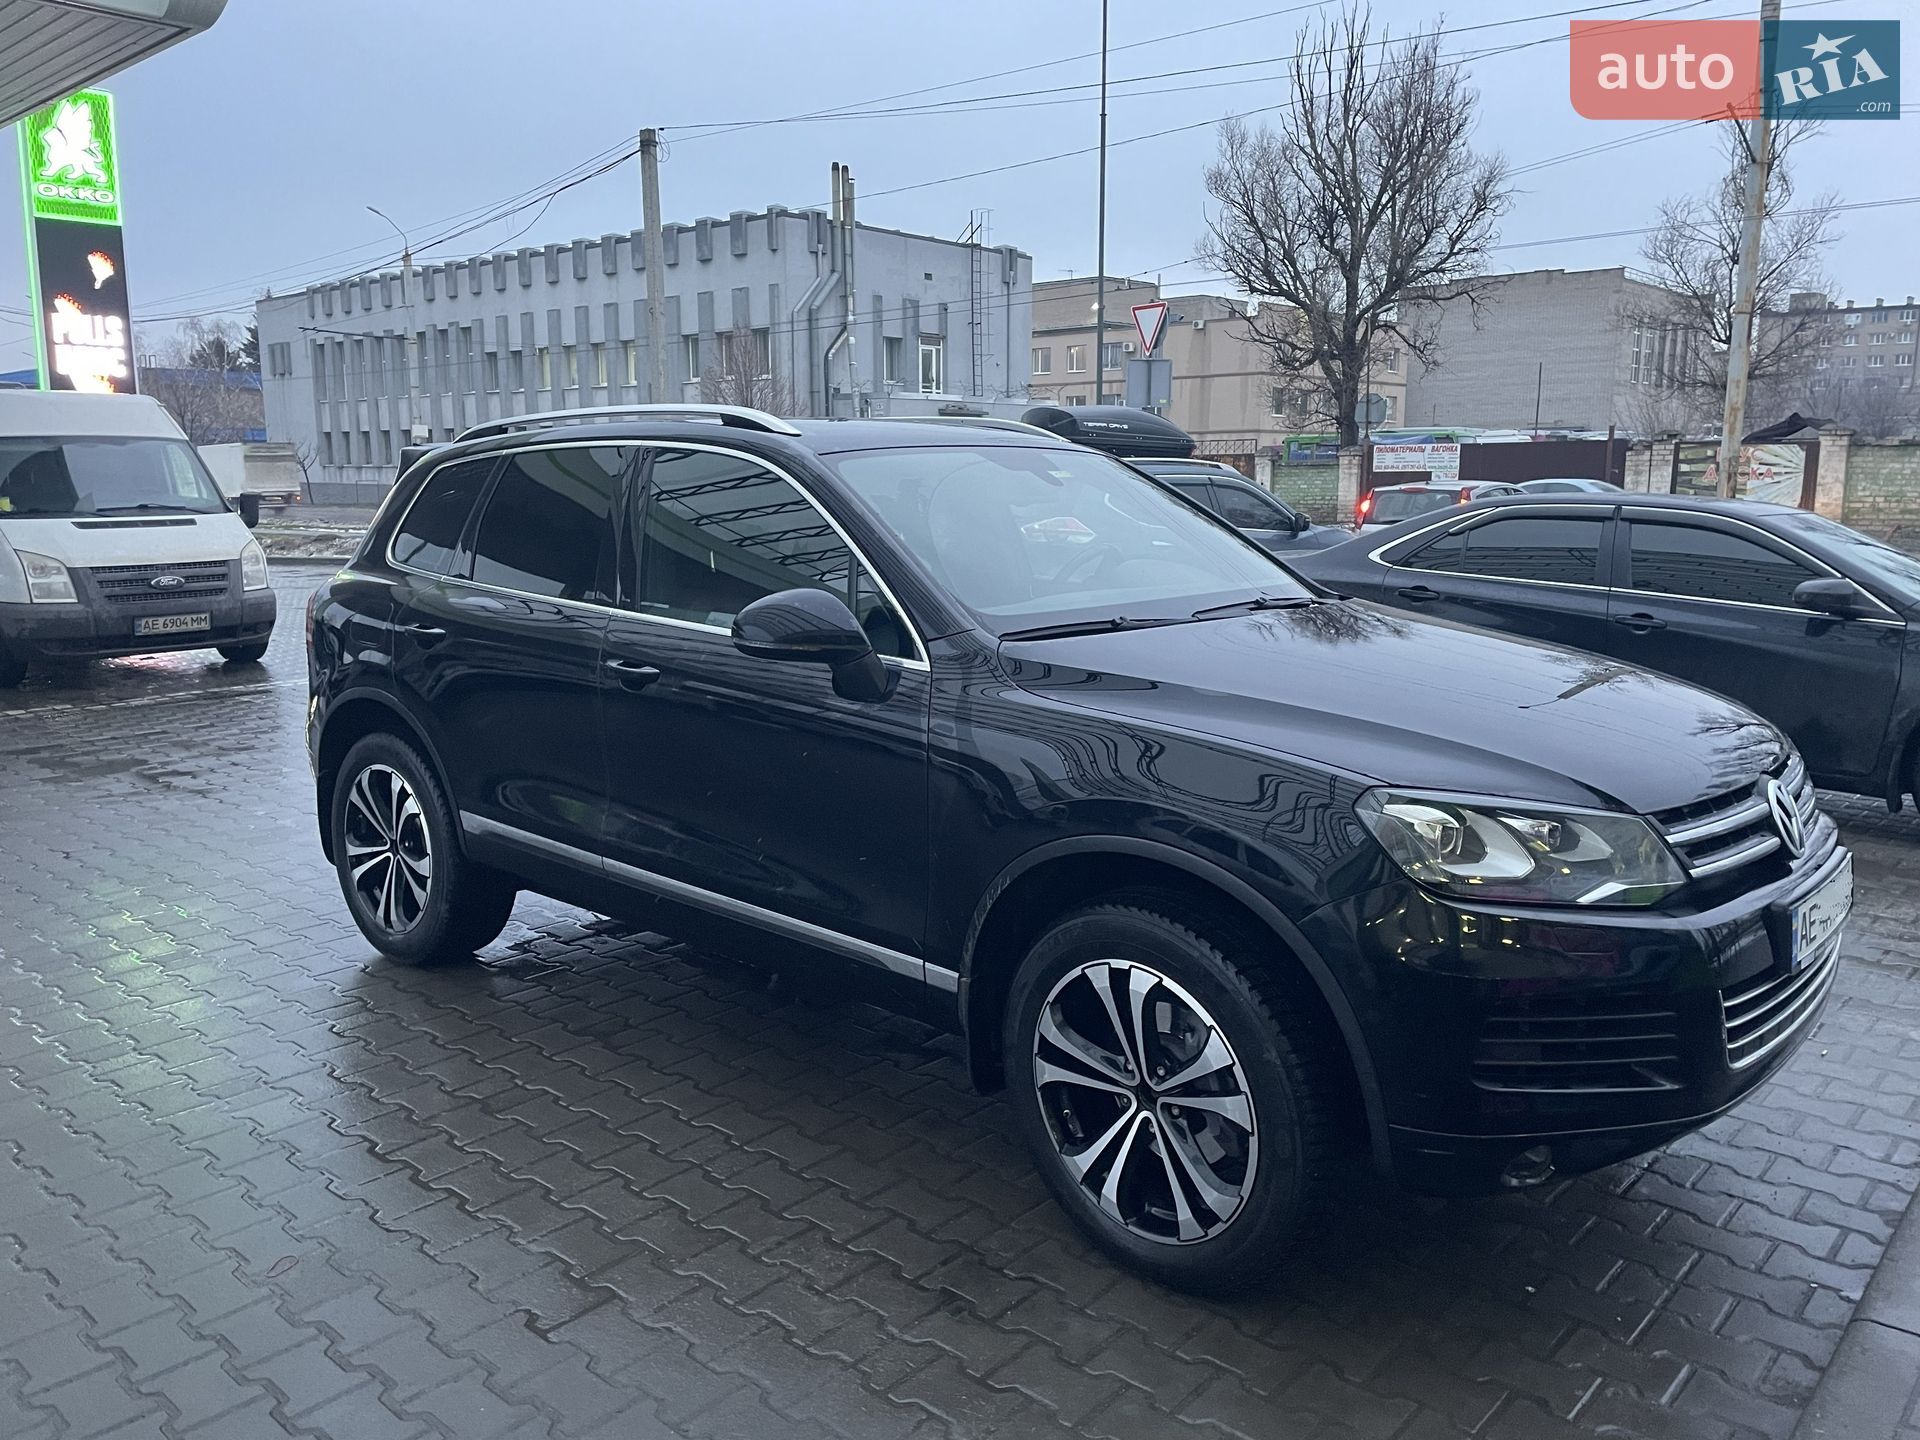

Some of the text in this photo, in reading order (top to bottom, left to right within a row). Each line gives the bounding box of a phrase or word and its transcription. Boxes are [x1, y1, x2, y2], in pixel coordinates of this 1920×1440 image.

[37, 183, 115, 203] OKKO
[1375, 445, 1458, 454] ПИЛОМАТЕРИАЛЫ ВАГОНКА
[1703, 464, 1775, 481] ДСКА
[143, 615, 208, 631] AE 6904 MM
[1799, 903, 1817, 953] AE
